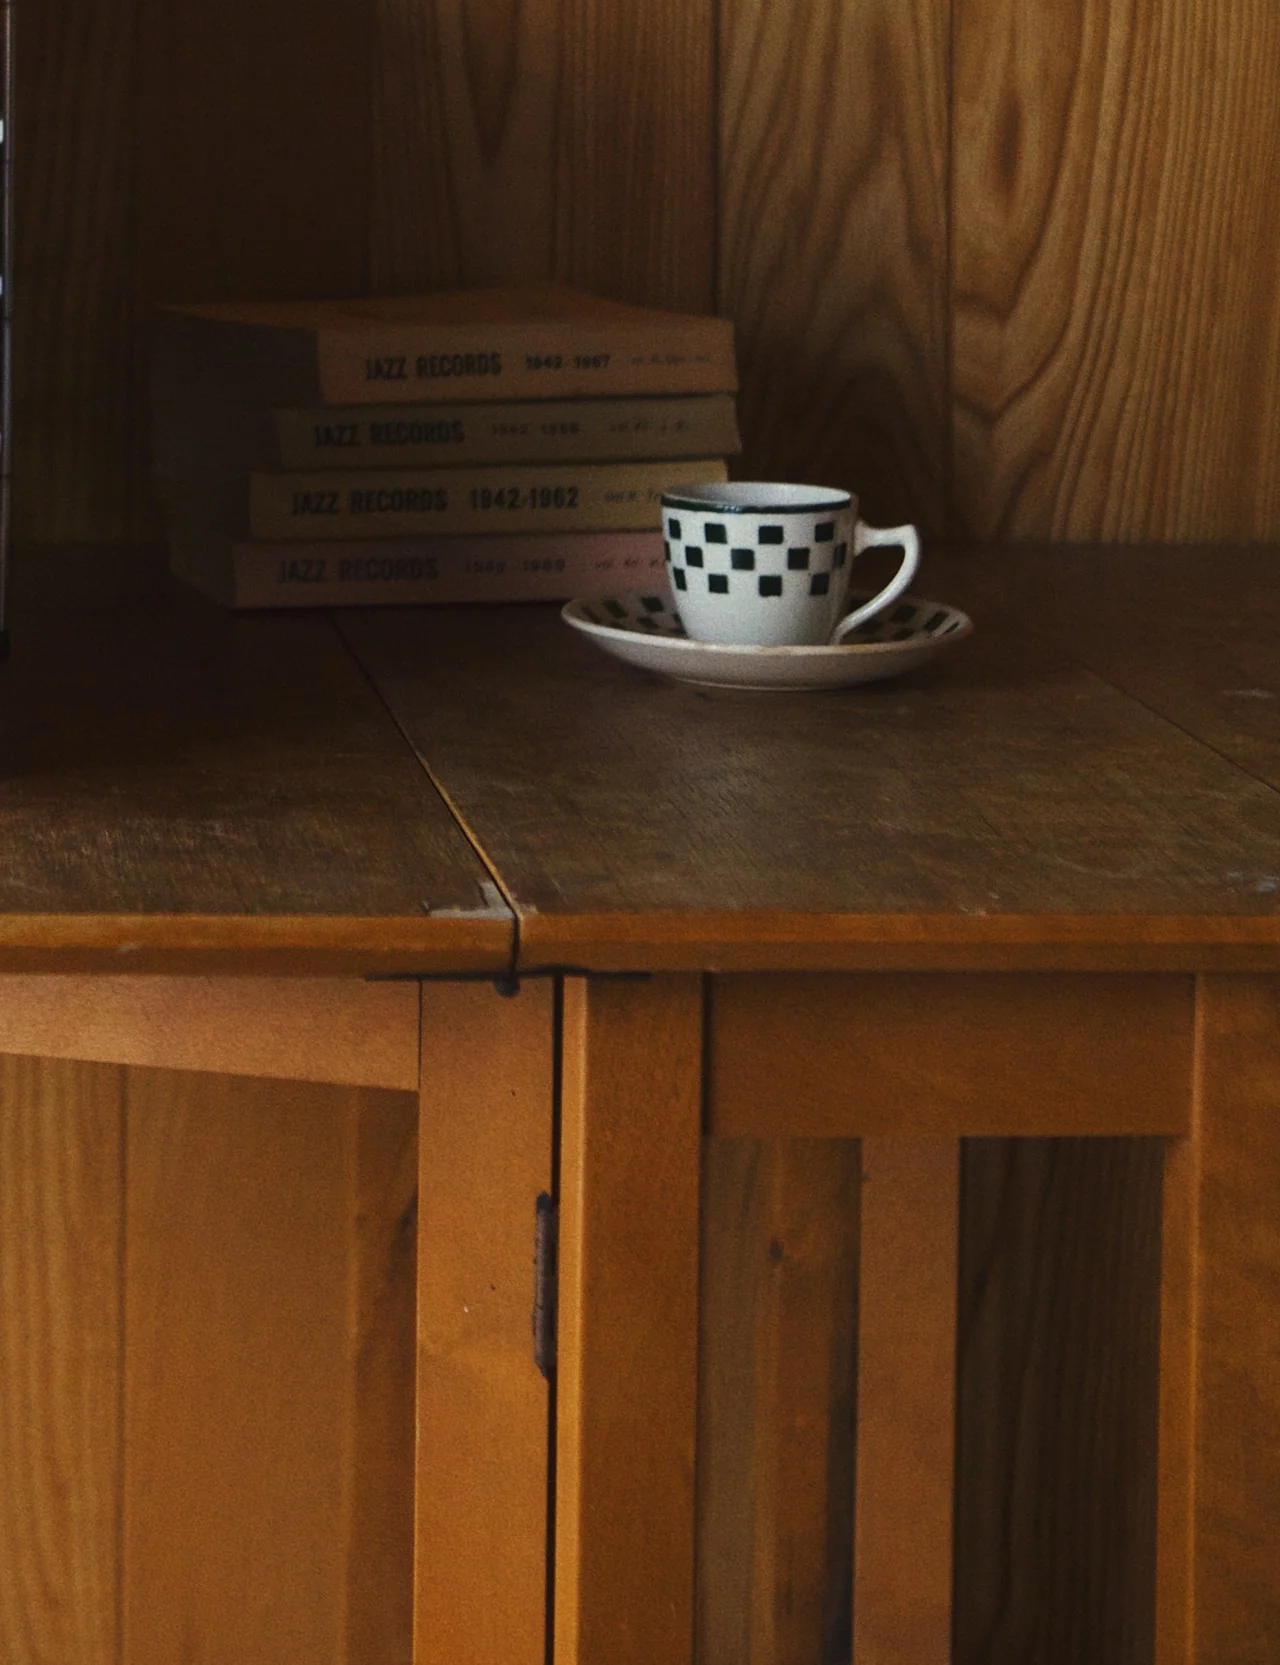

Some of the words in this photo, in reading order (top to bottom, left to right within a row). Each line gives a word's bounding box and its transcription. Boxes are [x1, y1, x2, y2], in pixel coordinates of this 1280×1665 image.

[366, 358, 407, 381] JAZZ
[416, 353, 502, 378] RECORDS
[314, 424, 360, 448] JAZZ
[369, 420, 465, 445] RECORDS
[291, 492, 338, 515] JAZZ
[350, 489, 447, 513] RECORDS
[469, 487, 579, 510] 1942-1962
[279, 559, 327, 584] JAZZ
[338, 557, 438, 580] RECORDS
